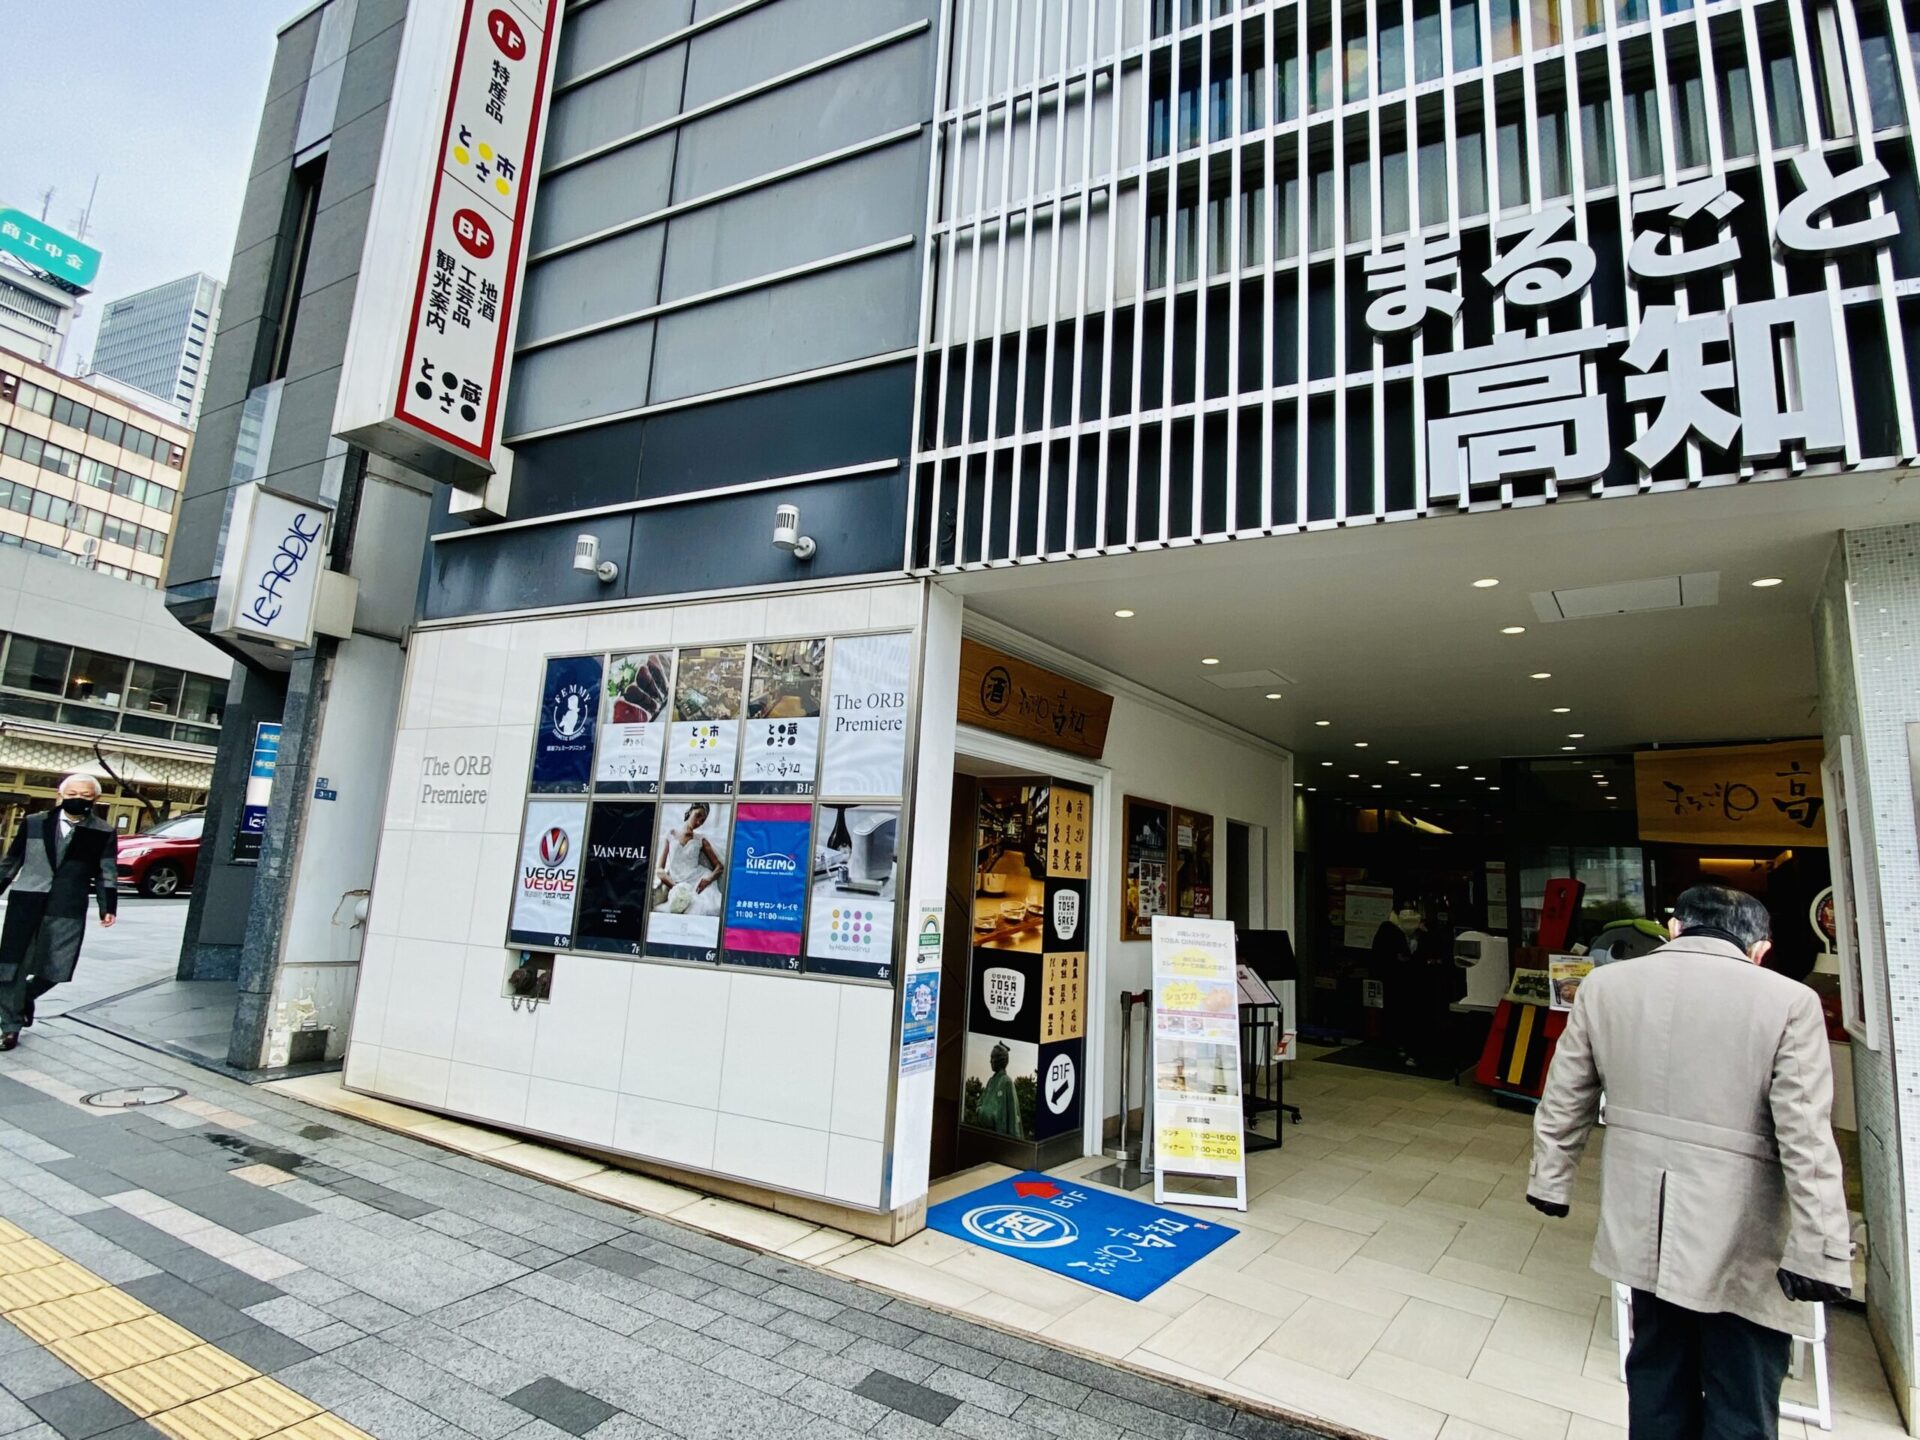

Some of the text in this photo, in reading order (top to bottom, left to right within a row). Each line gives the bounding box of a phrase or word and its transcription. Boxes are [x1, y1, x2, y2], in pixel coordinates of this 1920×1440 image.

[495, 20, 522, 49] 1F
[485, 60, 511, 124] 特産品
[458, 217, 490, 248] BF
[2, 221, 83, 271] 商工中金
[1364, 148, 1901, 333] まるごと
[426, 249, 455, 335] 観光案内
[452, 264, 478, 329] 工芸品
[477, 278, 498, 323] 地酒
[1423, 290, 1845, 500] 高知
[554, 683, 592, 704] FEMMY
[834, 692, 905, 710] The ORB
[835, 715, 903, 732] Premiere
[423, 755, 492, 776] The ORB
[421, 783, 488, 804] Premiere
[581, 783, 590, 793] 3F
[649, 783, 659, 793] 2F
[723, 783, 733, 793] 1F
[797, 783, 814, 794] B1F
[592, 844, 648, 859] VAN-VEAL
[746, 856, 797, 871] KIREIMO
[525, 866, 576, 880] VEGAS
[524, 878, 575, 892] VEGAS
[776, 902, 799, 911] キレイモ
[1058, 901, 1075, 911] TOSA
[1057, 915, 1075, 926] SAKE
[553, 936, 570, 947] 8.9F
[631, 943, 641, 954] 7F
[705, 949, 717, 961] 6F
[788, 958, 800, 970] 5F
[877, 966, 890, 978] 4F
[991, 979, 1016, 992] TOSA
[990, 994, 1016, 1008] SAKE
[1052, 1062, 1071, 1082] B1F
[1050, 1190, 1089, 1209] B1F
